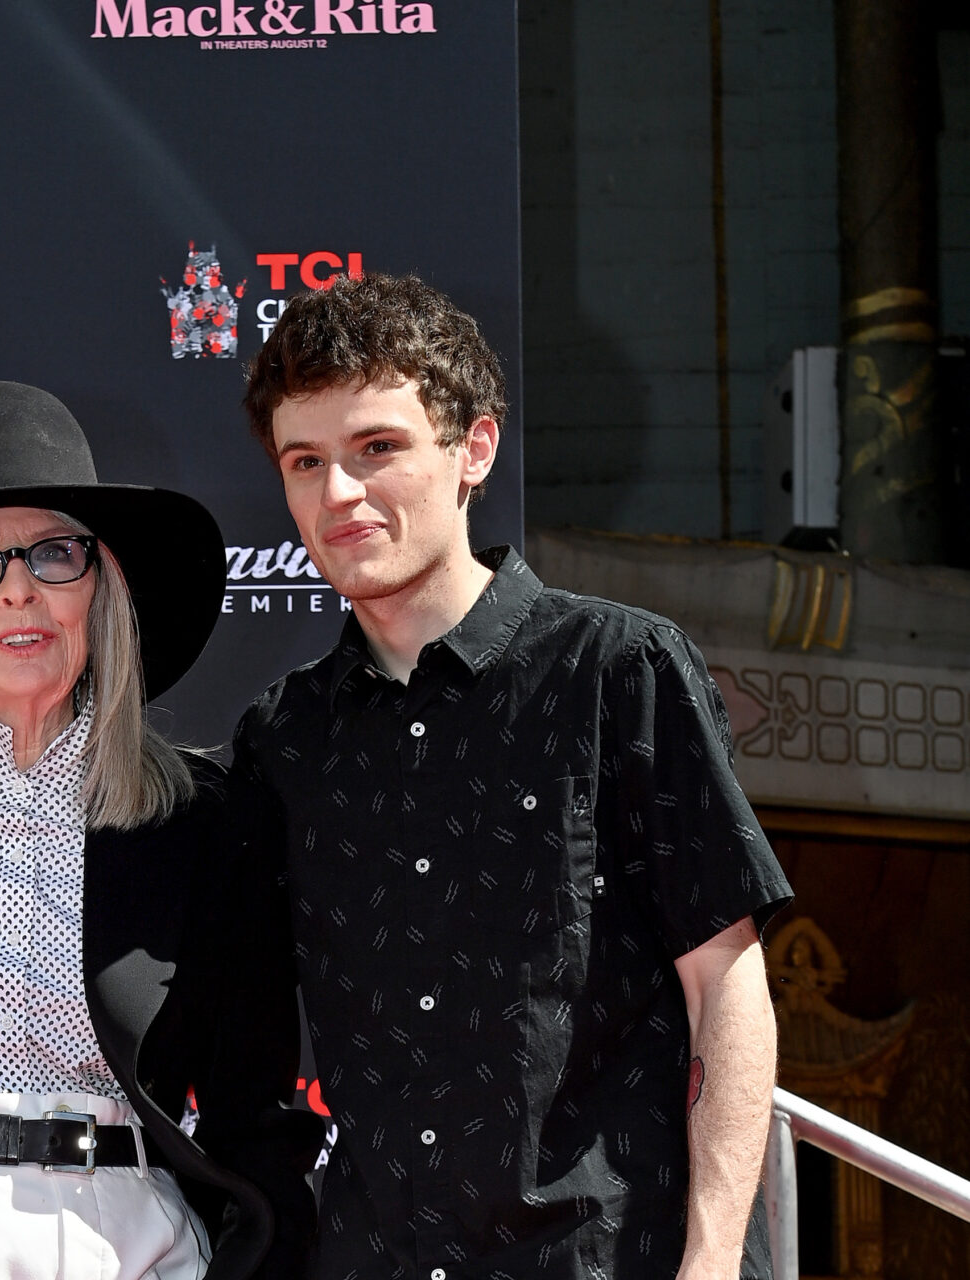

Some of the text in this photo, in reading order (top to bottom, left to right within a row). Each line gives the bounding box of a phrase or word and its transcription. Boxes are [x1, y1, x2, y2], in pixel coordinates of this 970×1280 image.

[200, 39, 328, 50] IN THEATERS AUGUST 12
